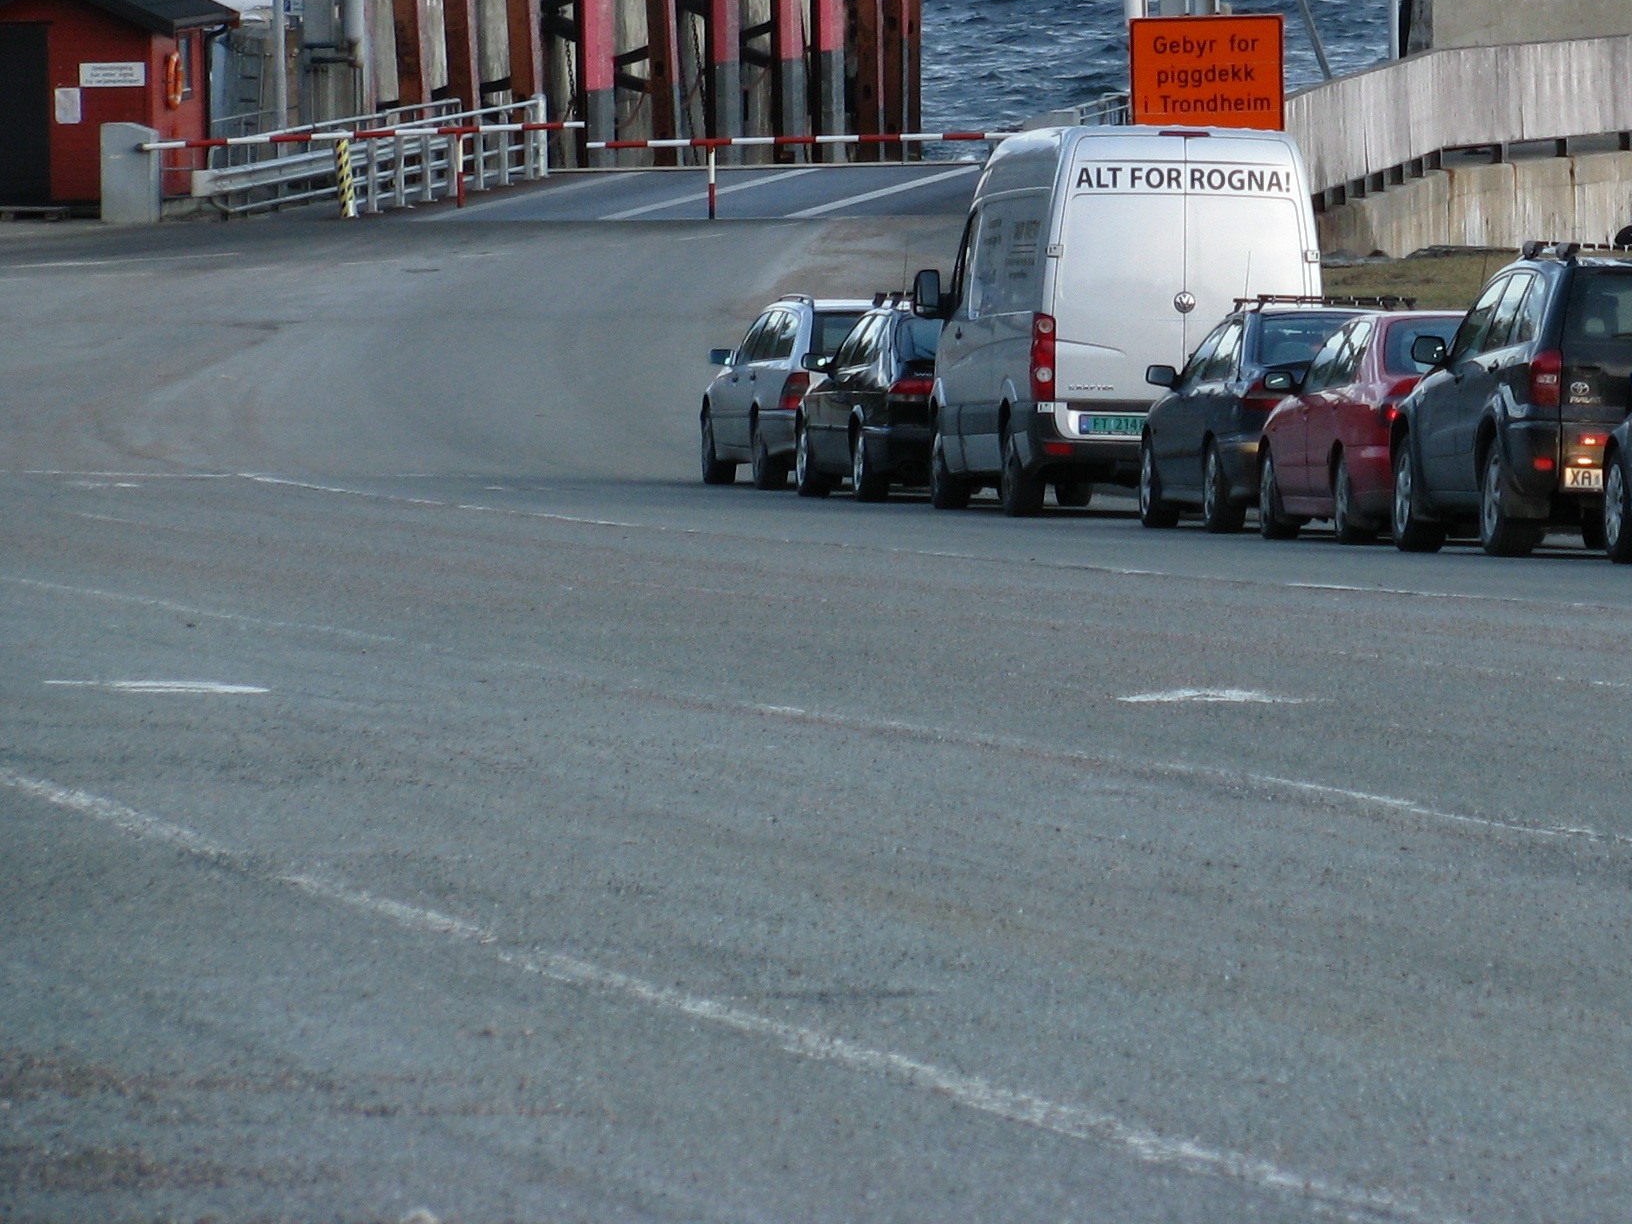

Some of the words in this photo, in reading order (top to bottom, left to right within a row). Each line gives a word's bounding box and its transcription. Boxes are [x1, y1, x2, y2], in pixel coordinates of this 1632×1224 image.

[1154, 35, 1217, 58] Gebyr
[1229, 34, 1259, 52] for
[1157, 64, 1255, 88] piggdekk
[1144, 96, 1149, 114] i
[1160, 93, 1271, 113] Trondheim
[1076, 167, 1122, 189] ALT
[1130, 167, 1182, 189] FOR
[1190, 169, 1291, 193] ROGNA!
[1093, 418, 1108, 430] FT
[1570, 470, 1592, 486] XA
